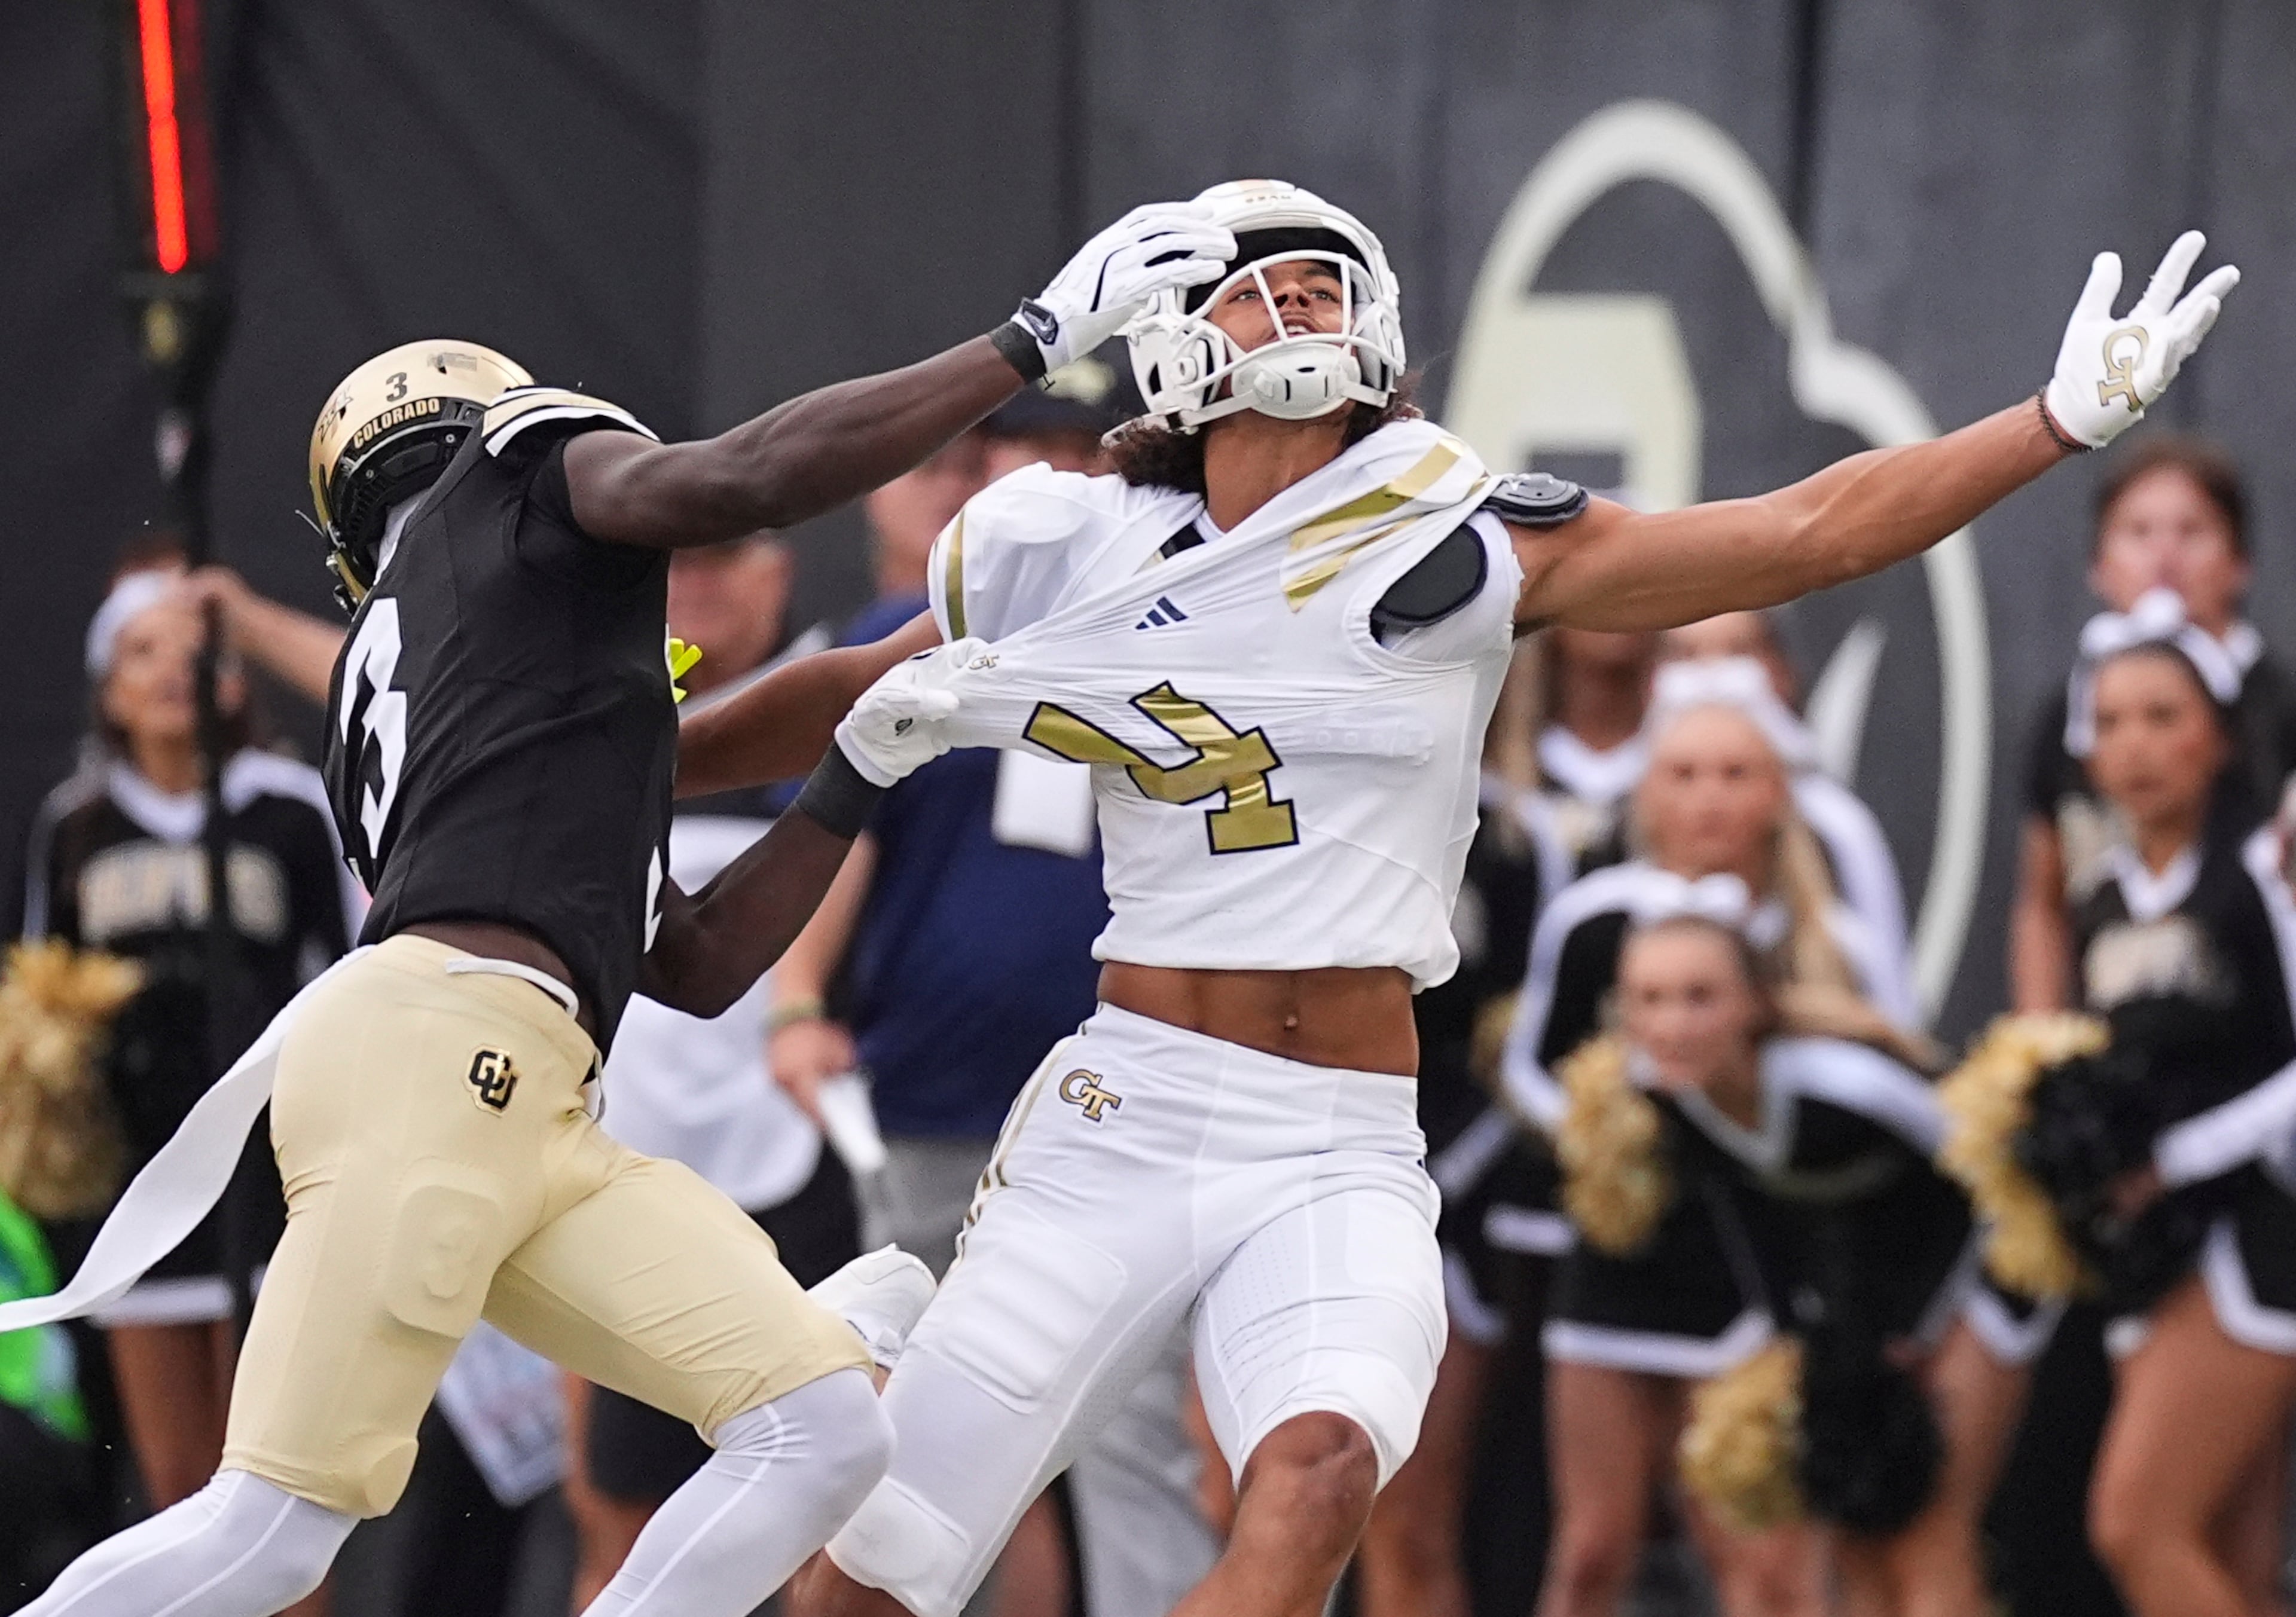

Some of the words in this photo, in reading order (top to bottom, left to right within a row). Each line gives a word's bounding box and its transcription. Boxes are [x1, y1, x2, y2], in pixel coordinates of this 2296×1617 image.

[386, 371, 408, 402] 3
[2097, 325, 2150, 412] GT
[353, 398, 441, 449] COLORADO
[338, 597, 407, 859] 3
[1022, 680, 1300, 855] 4
[1059, 1068, 1122, 1123] GT
